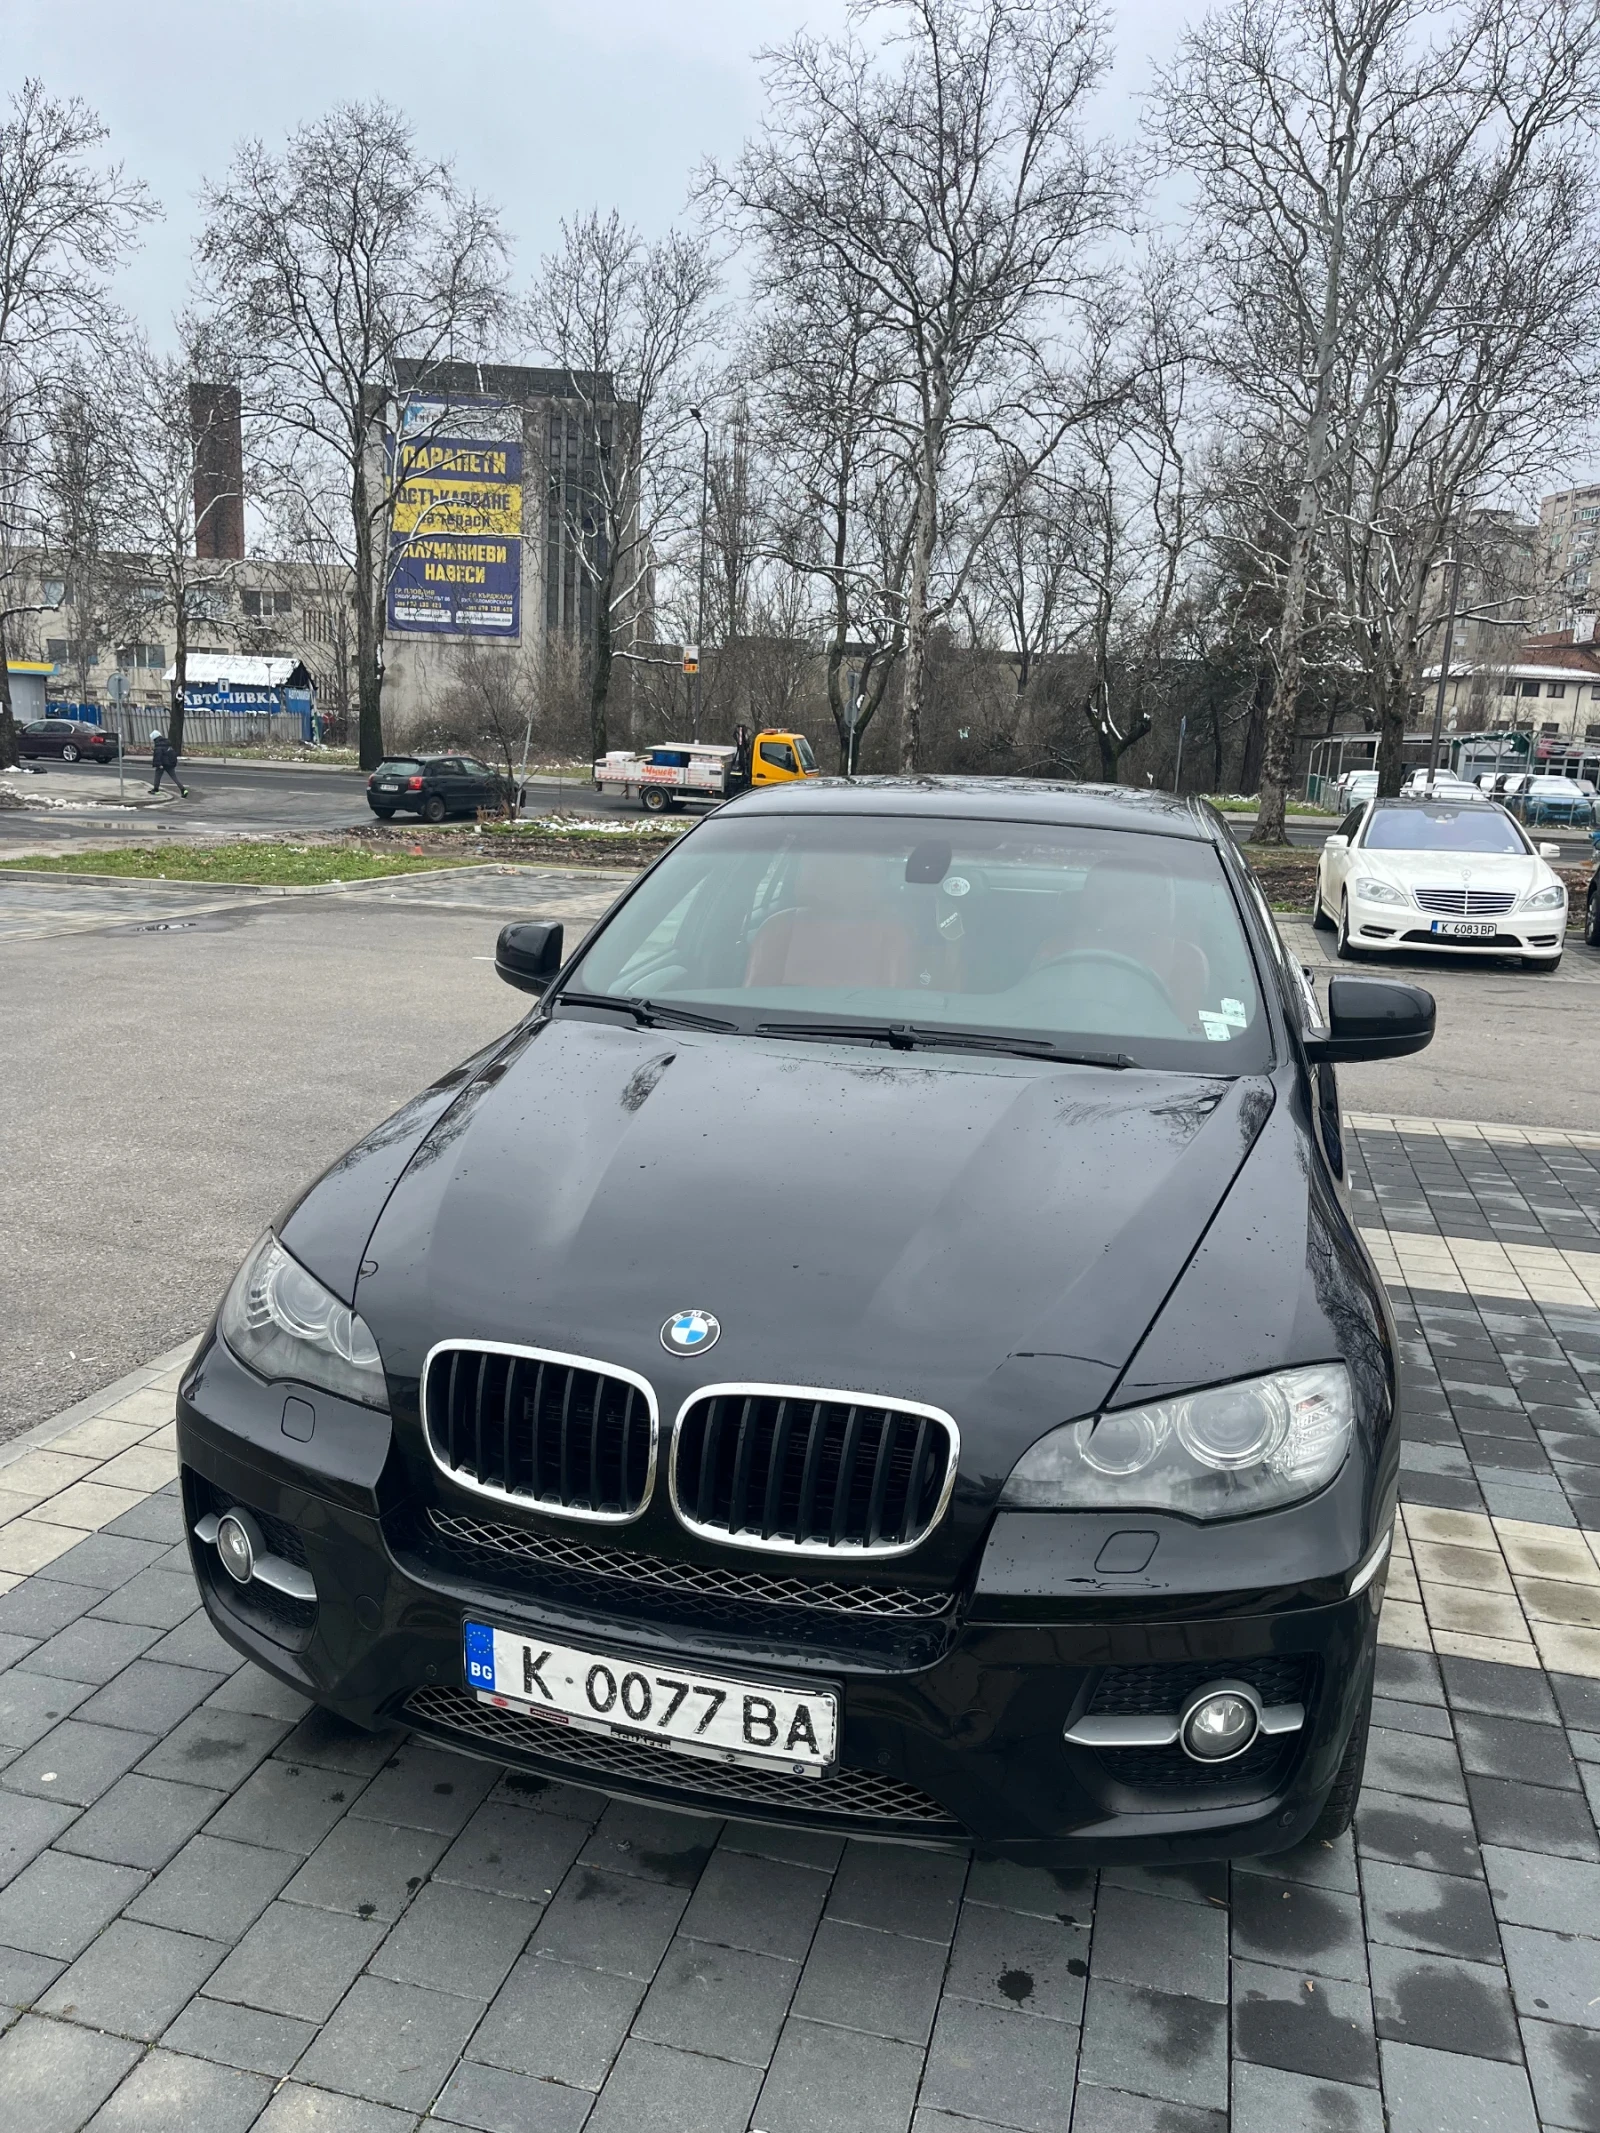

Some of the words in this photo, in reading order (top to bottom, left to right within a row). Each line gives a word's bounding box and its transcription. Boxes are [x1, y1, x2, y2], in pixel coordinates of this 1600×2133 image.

[425, 563, 486, 584] НАВЕСИ
[184, 691, 280, 706] АВТОМИВКА
[1442, 923, 1449, 933] K
[1453, 924, 1479, 935] 6083
[1481, 925, 1494, 935] BP
[470, 1661, 493, 1680] BG
[521, 1645, 555, 1701] K
[585, 1663, 728, 1736] 0077
[741, 1694, 821, 1756] BA
